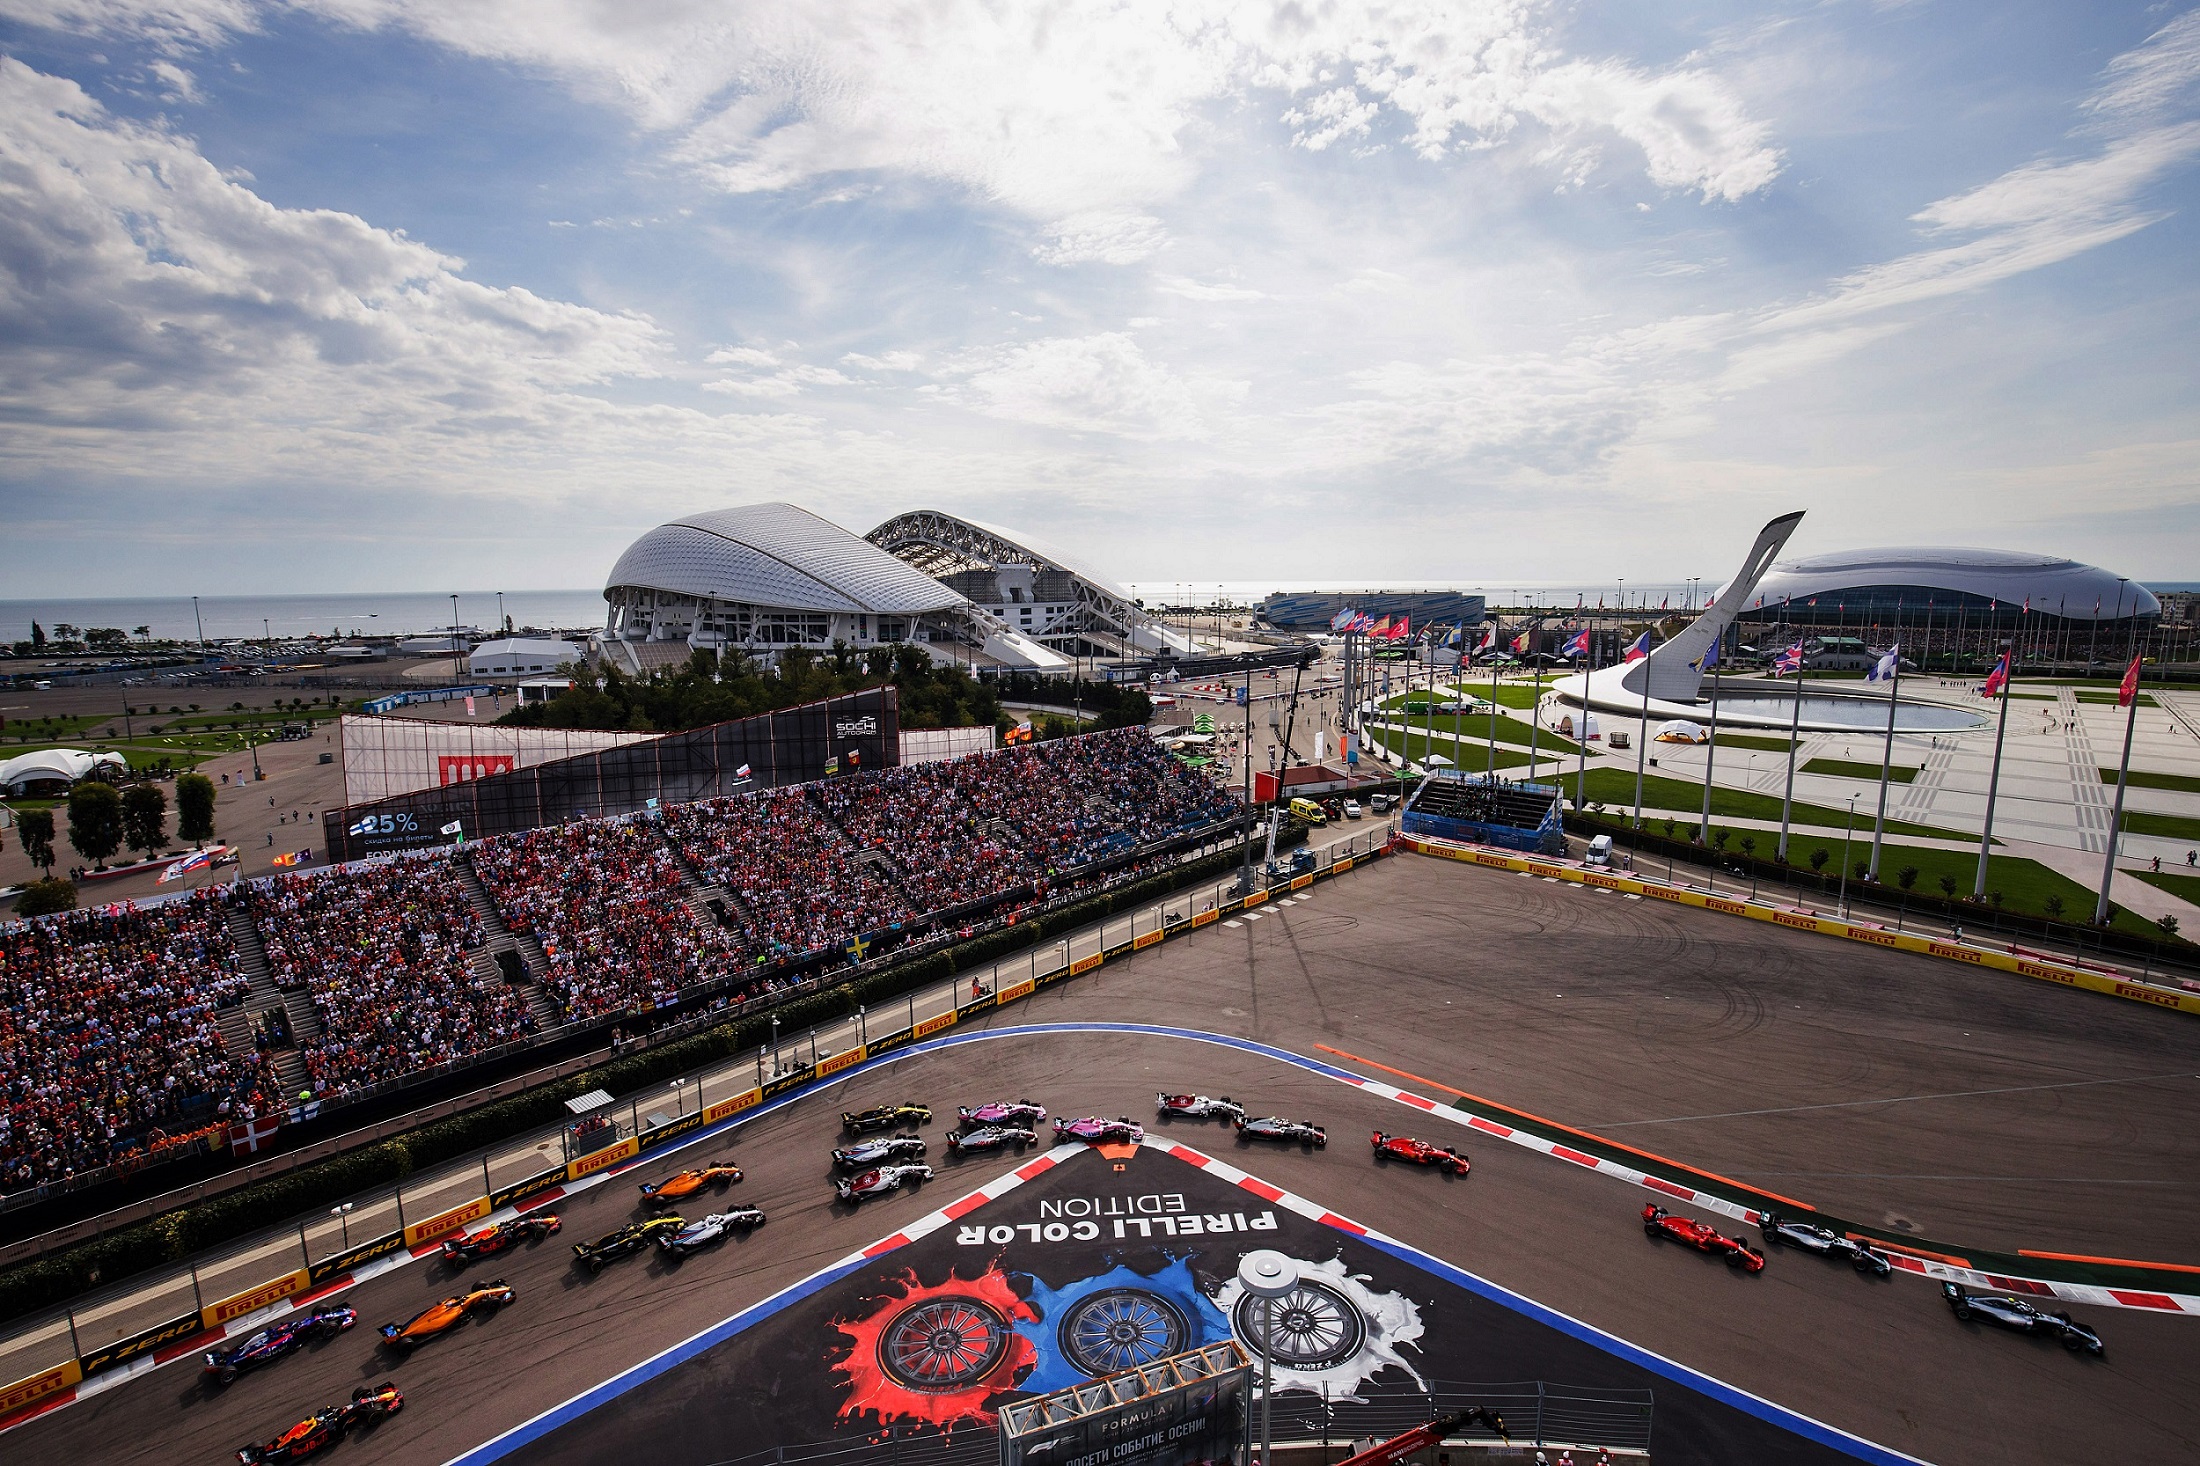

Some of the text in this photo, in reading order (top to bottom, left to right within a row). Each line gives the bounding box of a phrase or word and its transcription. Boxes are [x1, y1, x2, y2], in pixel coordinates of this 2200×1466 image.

[836, 722, 876, 731] SOCHI
[364, 812, 418, 835] 25%
[364, 837, 391, 845] скидка
[406, 834, 434, 842] билеты
[1426, 845, 1456, 858] PIRELLI
[1476, 854, 1507, 867] PIRELLI
[1528, 863, 1562, 877] PIRELLI
[1583, 874, 1619, 887] PIRELLI
[1247, 893, 1266, 906] PIRELLI
[1643, 885, 1680, 900] PIRELLI
[1705, 898, 1745, 914] PIRELLI
[1171, 922, 1192, 933] ZERO
[1195, 912, 1216, 926] PIRELLI
[1773, 912, 1817, 929] PIRELLI
[1137, 932, 1160, 947] PIRELLI
[1848, 927, 1896, 945] PIRELLI
[1110, 944, 1133, 957] ZERO
[1929, 942, 1982, 963] PIRELLI
[1074, 956, 1098, 972] PIRELLI
[2017, 962, 2075, 983] PIRELLI
[1045, 969, 1069, 982] ZERO
[1001, 982, 1030, 1001] PIRELLI
[2115, 983, 2180, 1007] PIRELLI
[959, 998, 996, 1018] P ZERO
[918, 1014, 952, 1035] PIRELLI
[869, 1032, 912, 1053] P ZERO
[822, 1050, 860, 1074] PIRELLI
[765, 1071, 815, 1096] P ZERO
[710, 1093, 754, 1119] PIRELLI
[641, 1117, 700, 1146] P ZERO
[576, 1143, 629, 1174] PIRELLI
[495, 1171, 565, 1206] P ZERO
[1040, 1193, 1186, 1219] EDITION
[416, 1203, 480, 1240] PIRELLI
[956, 1211, 1278, 1245] PIRELLI COLOR
[315, 1238, 401, 1278] P ZERO
[216, 1277, 296, 1321] PIRELLI
[88, 1320, 197, 1371] P ZERO
[1102, 1407, 1166, 1432] FORMULA
[1113, 1431, 1165, 1458] СОБЫТИЕ
[1168, 1417, 1206, 1440] ОСЕНИ!
